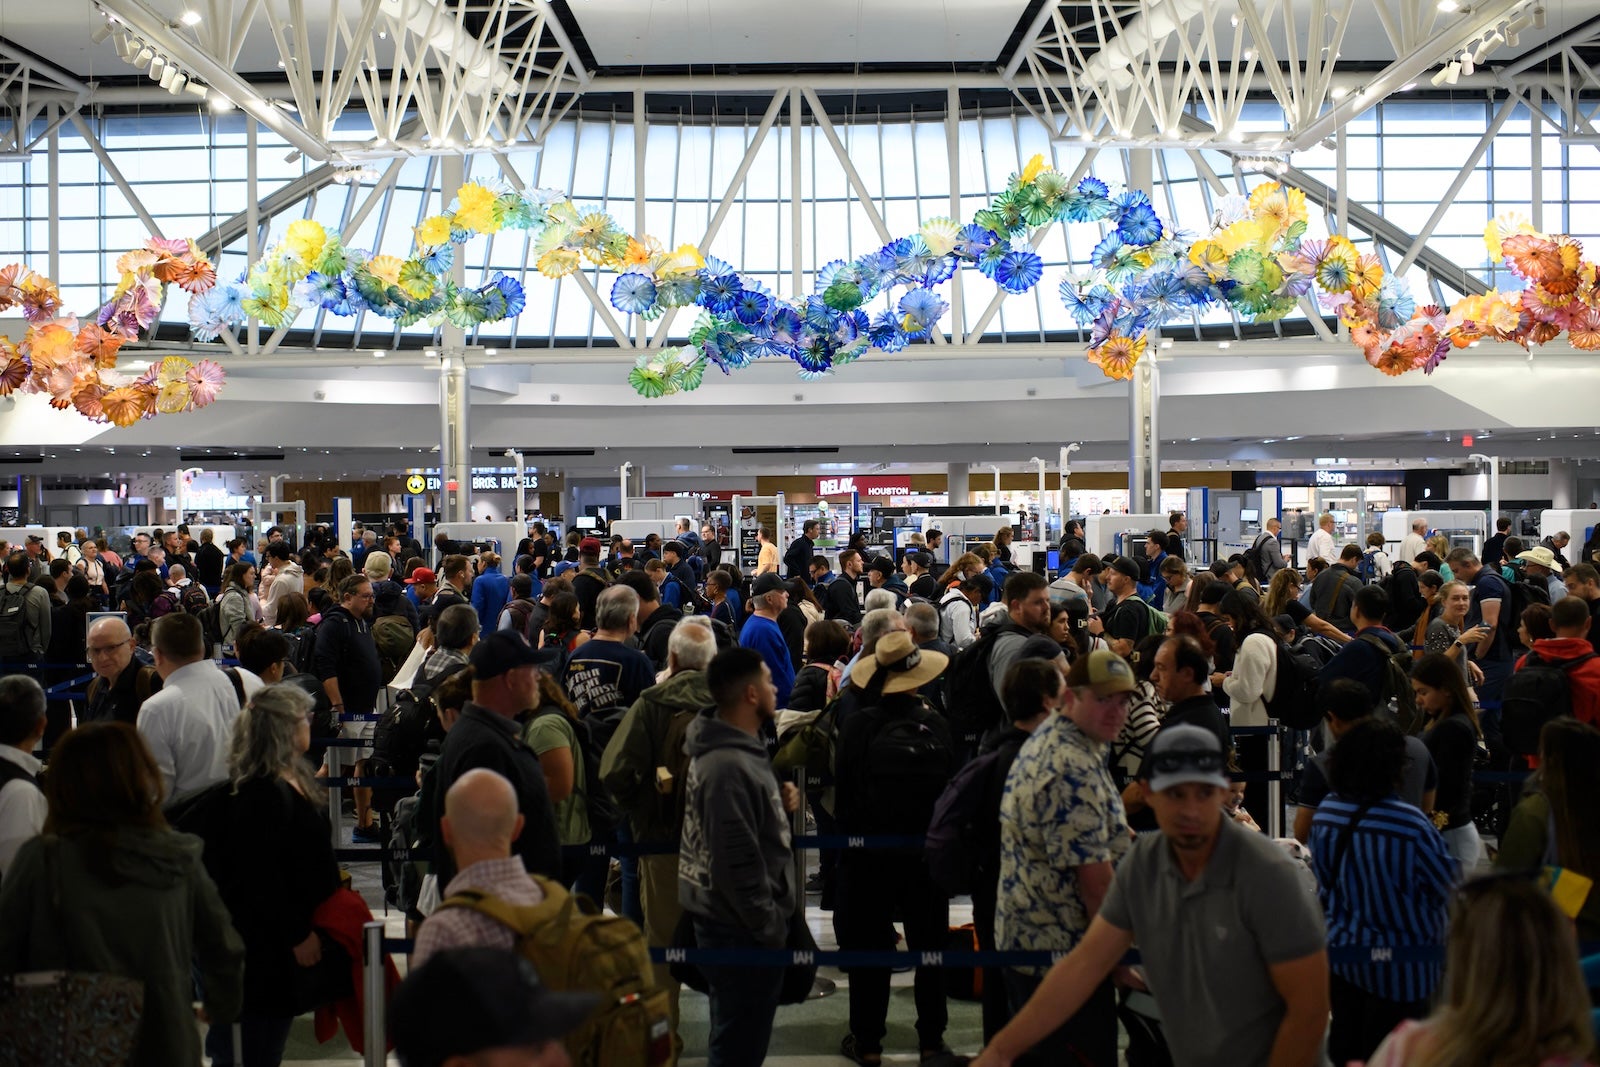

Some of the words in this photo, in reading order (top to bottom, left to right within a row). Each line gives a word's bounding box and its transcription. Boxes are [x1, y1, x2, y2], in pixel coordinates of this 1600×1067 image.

[472, 477, 498, 489] BROS.
[1316, 470, 1346, 484] iStore
[701, 493, 710, 501] go
[868, 487, 909, 495] HOUSTON
[347, 777, 360, 786] IAH
[808, 776, 821, 785] IAH
[848, 836, 864, 848] IAH
[393, 849, 409, 861] IAH
[590, 845, 606, 856] IAH
[665, 948, 686, 963] IAH
[793, 950, 814, 965] IAH
[921, 951, 943, 966] IAH
[1371, 947, 1392, 961] IAH
